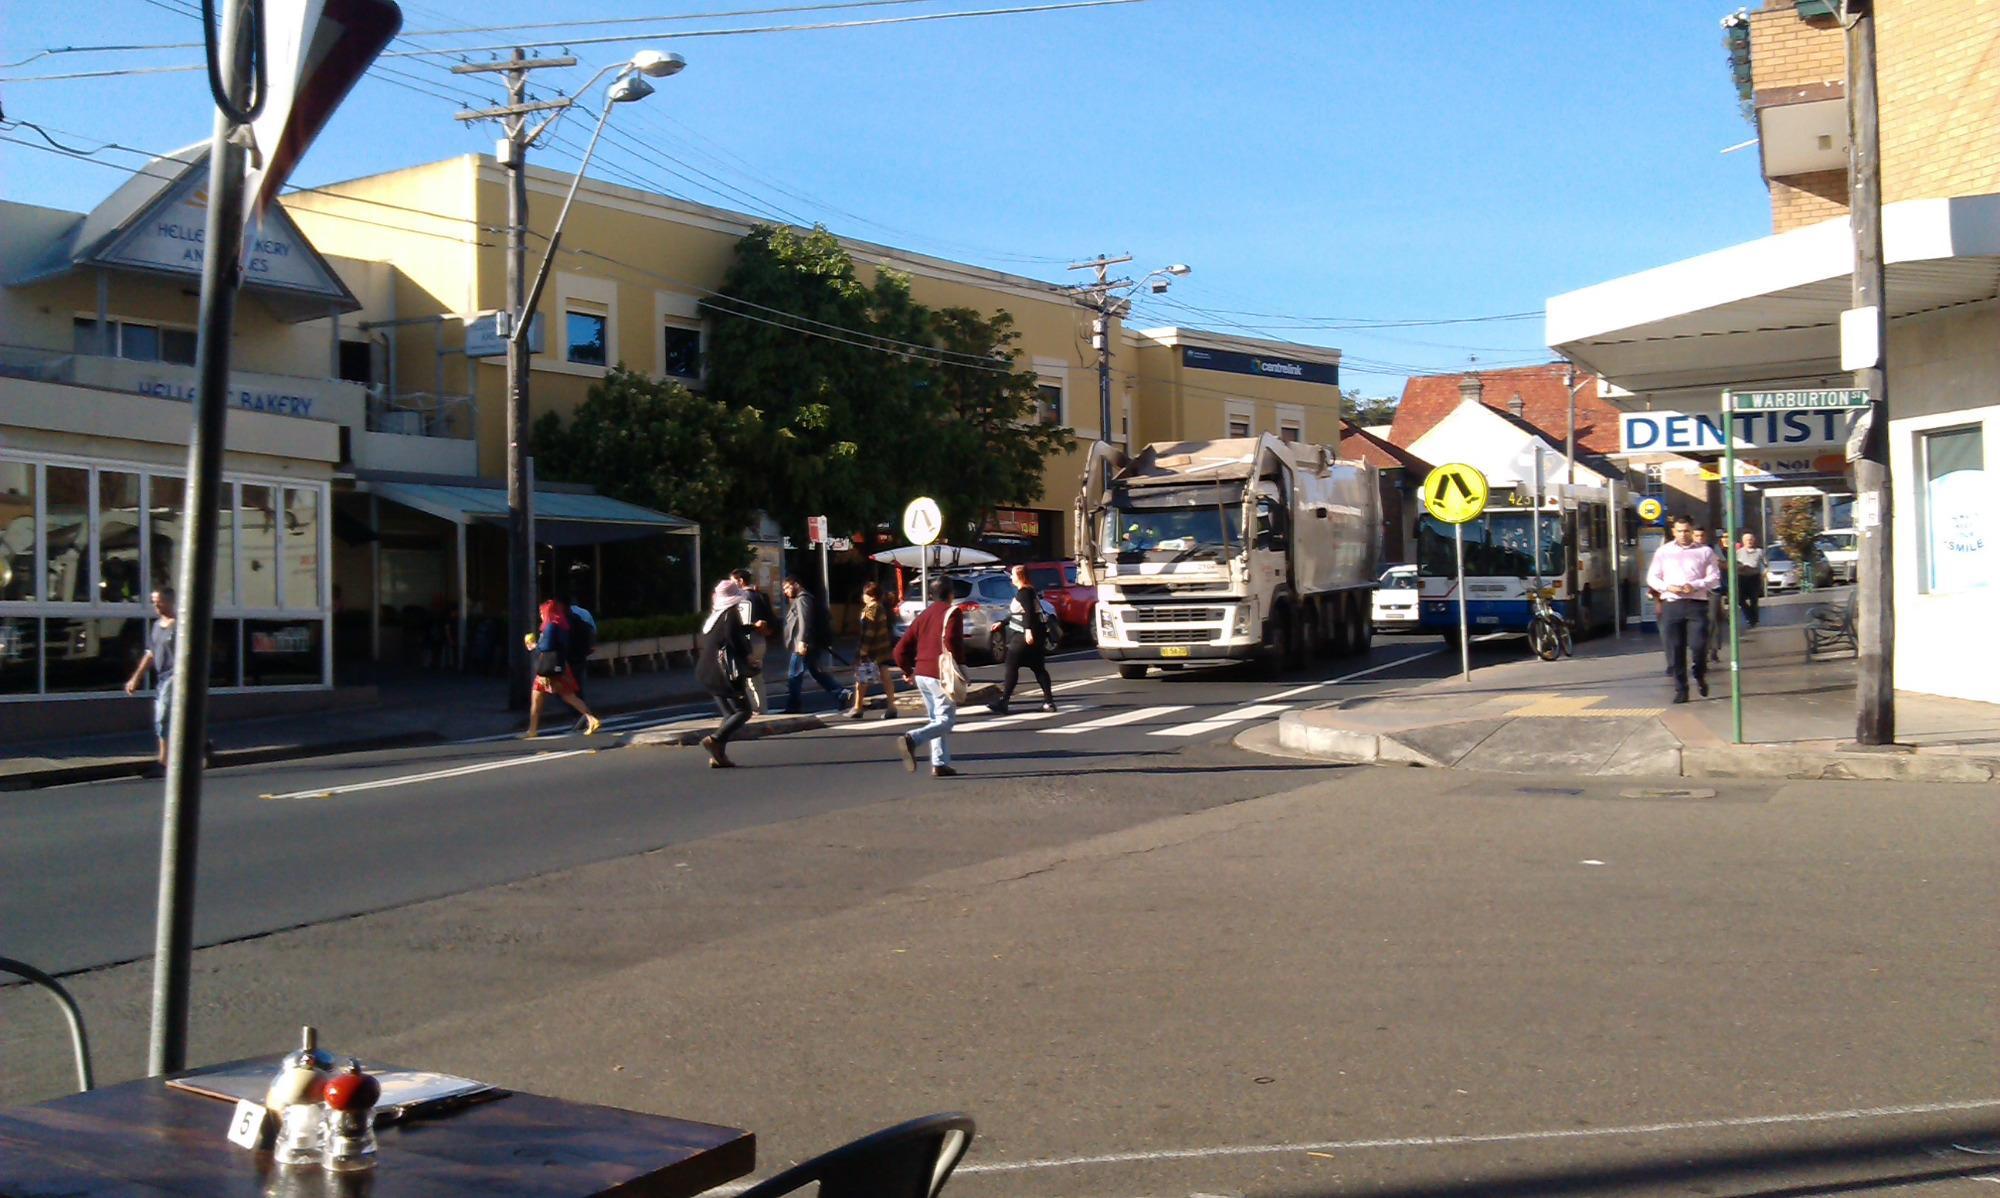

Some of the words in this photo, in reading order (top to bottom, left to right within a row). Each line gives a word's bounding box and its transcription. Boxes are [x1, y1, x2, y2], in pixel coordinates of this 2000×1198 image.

[158, 224, 205, 243] HELLE
[254, 239, 289, 256] KERY
[1261, 361, 1302, 376] centrelink
[240, 391, 312, 416] BAKERY
[1752, 391, 1849, 408] WARBURTON
[1626, 410, 1845, 449] DENTIST
[1509, 491, 1531, 506] 423
[240, 1111, 253, 1135] 5
